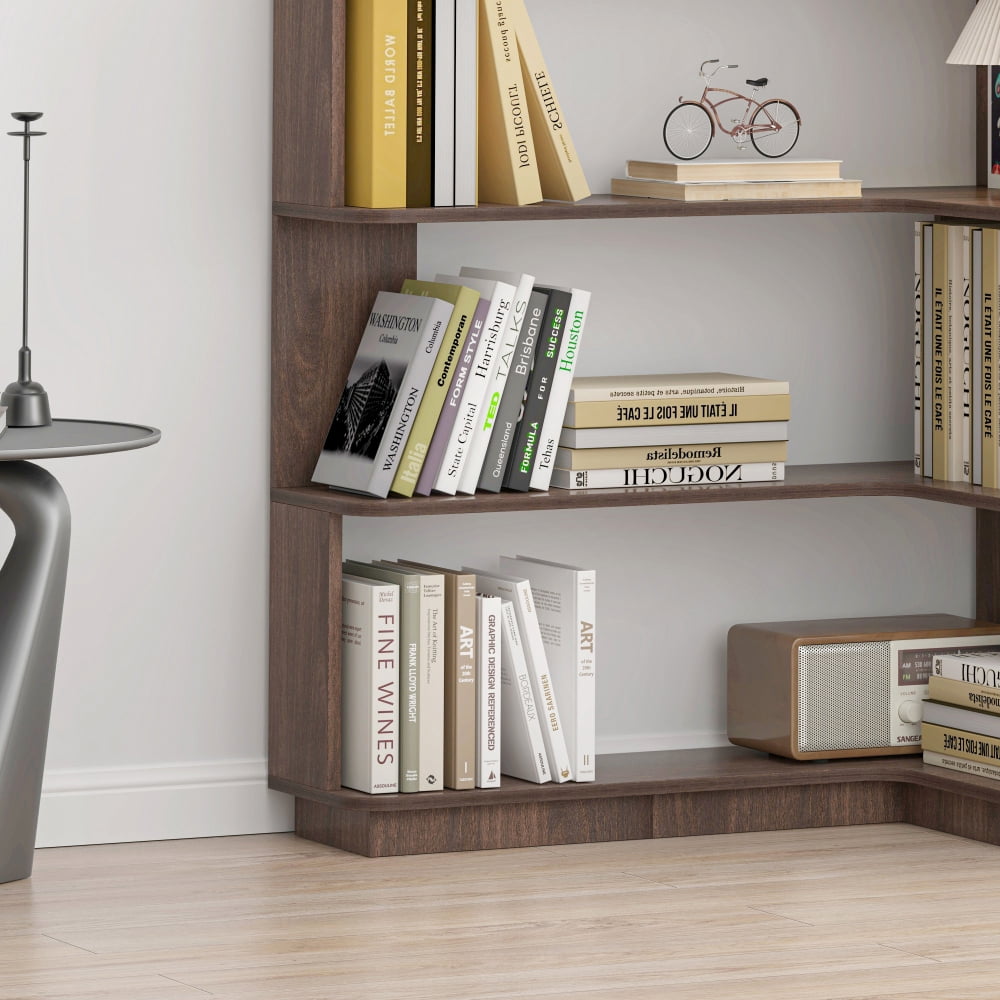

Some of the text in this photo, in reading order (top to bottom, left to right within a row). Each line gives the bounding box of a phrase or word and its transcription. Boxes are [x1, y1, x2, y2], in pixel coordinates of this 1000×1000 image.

[369, 312, 423, 333] WASHINGTON
[935, 288, 942, 298] IL
[984, 293, 992, 303] IL
[449, 319, 483, 408] FORM STYLE
[483, 300, 527, 431] TED TALKS
[559, 310, 584, 373] Houston
[984, 340, 992, 363] UNE
[383, 320, 442, 471] WASHINGTON Columbia
[401, 314, 468, 484] Italia Contemporan
[447, 298, 511, 478] State Capital Harrisburg
[492, 307, 541, 478] Queensland Brisbane
[520, 308, 564, 474] FORMULA FOR SUCCESS
[935, 386, 942, 400] LE
[984, 365, 992, 391] FOIS
[984, 393, 992, 407] LE
[459, 625, 474, 659] ART
[580, 620, 594, 654] ART
[376, 614, 395, 765] FINE WINES
[408, 643, 417, 723] FRANK LLOYD WRIGHT
[487, 614, 496, 751] GRAPHIC DESIGN REFERENCED
